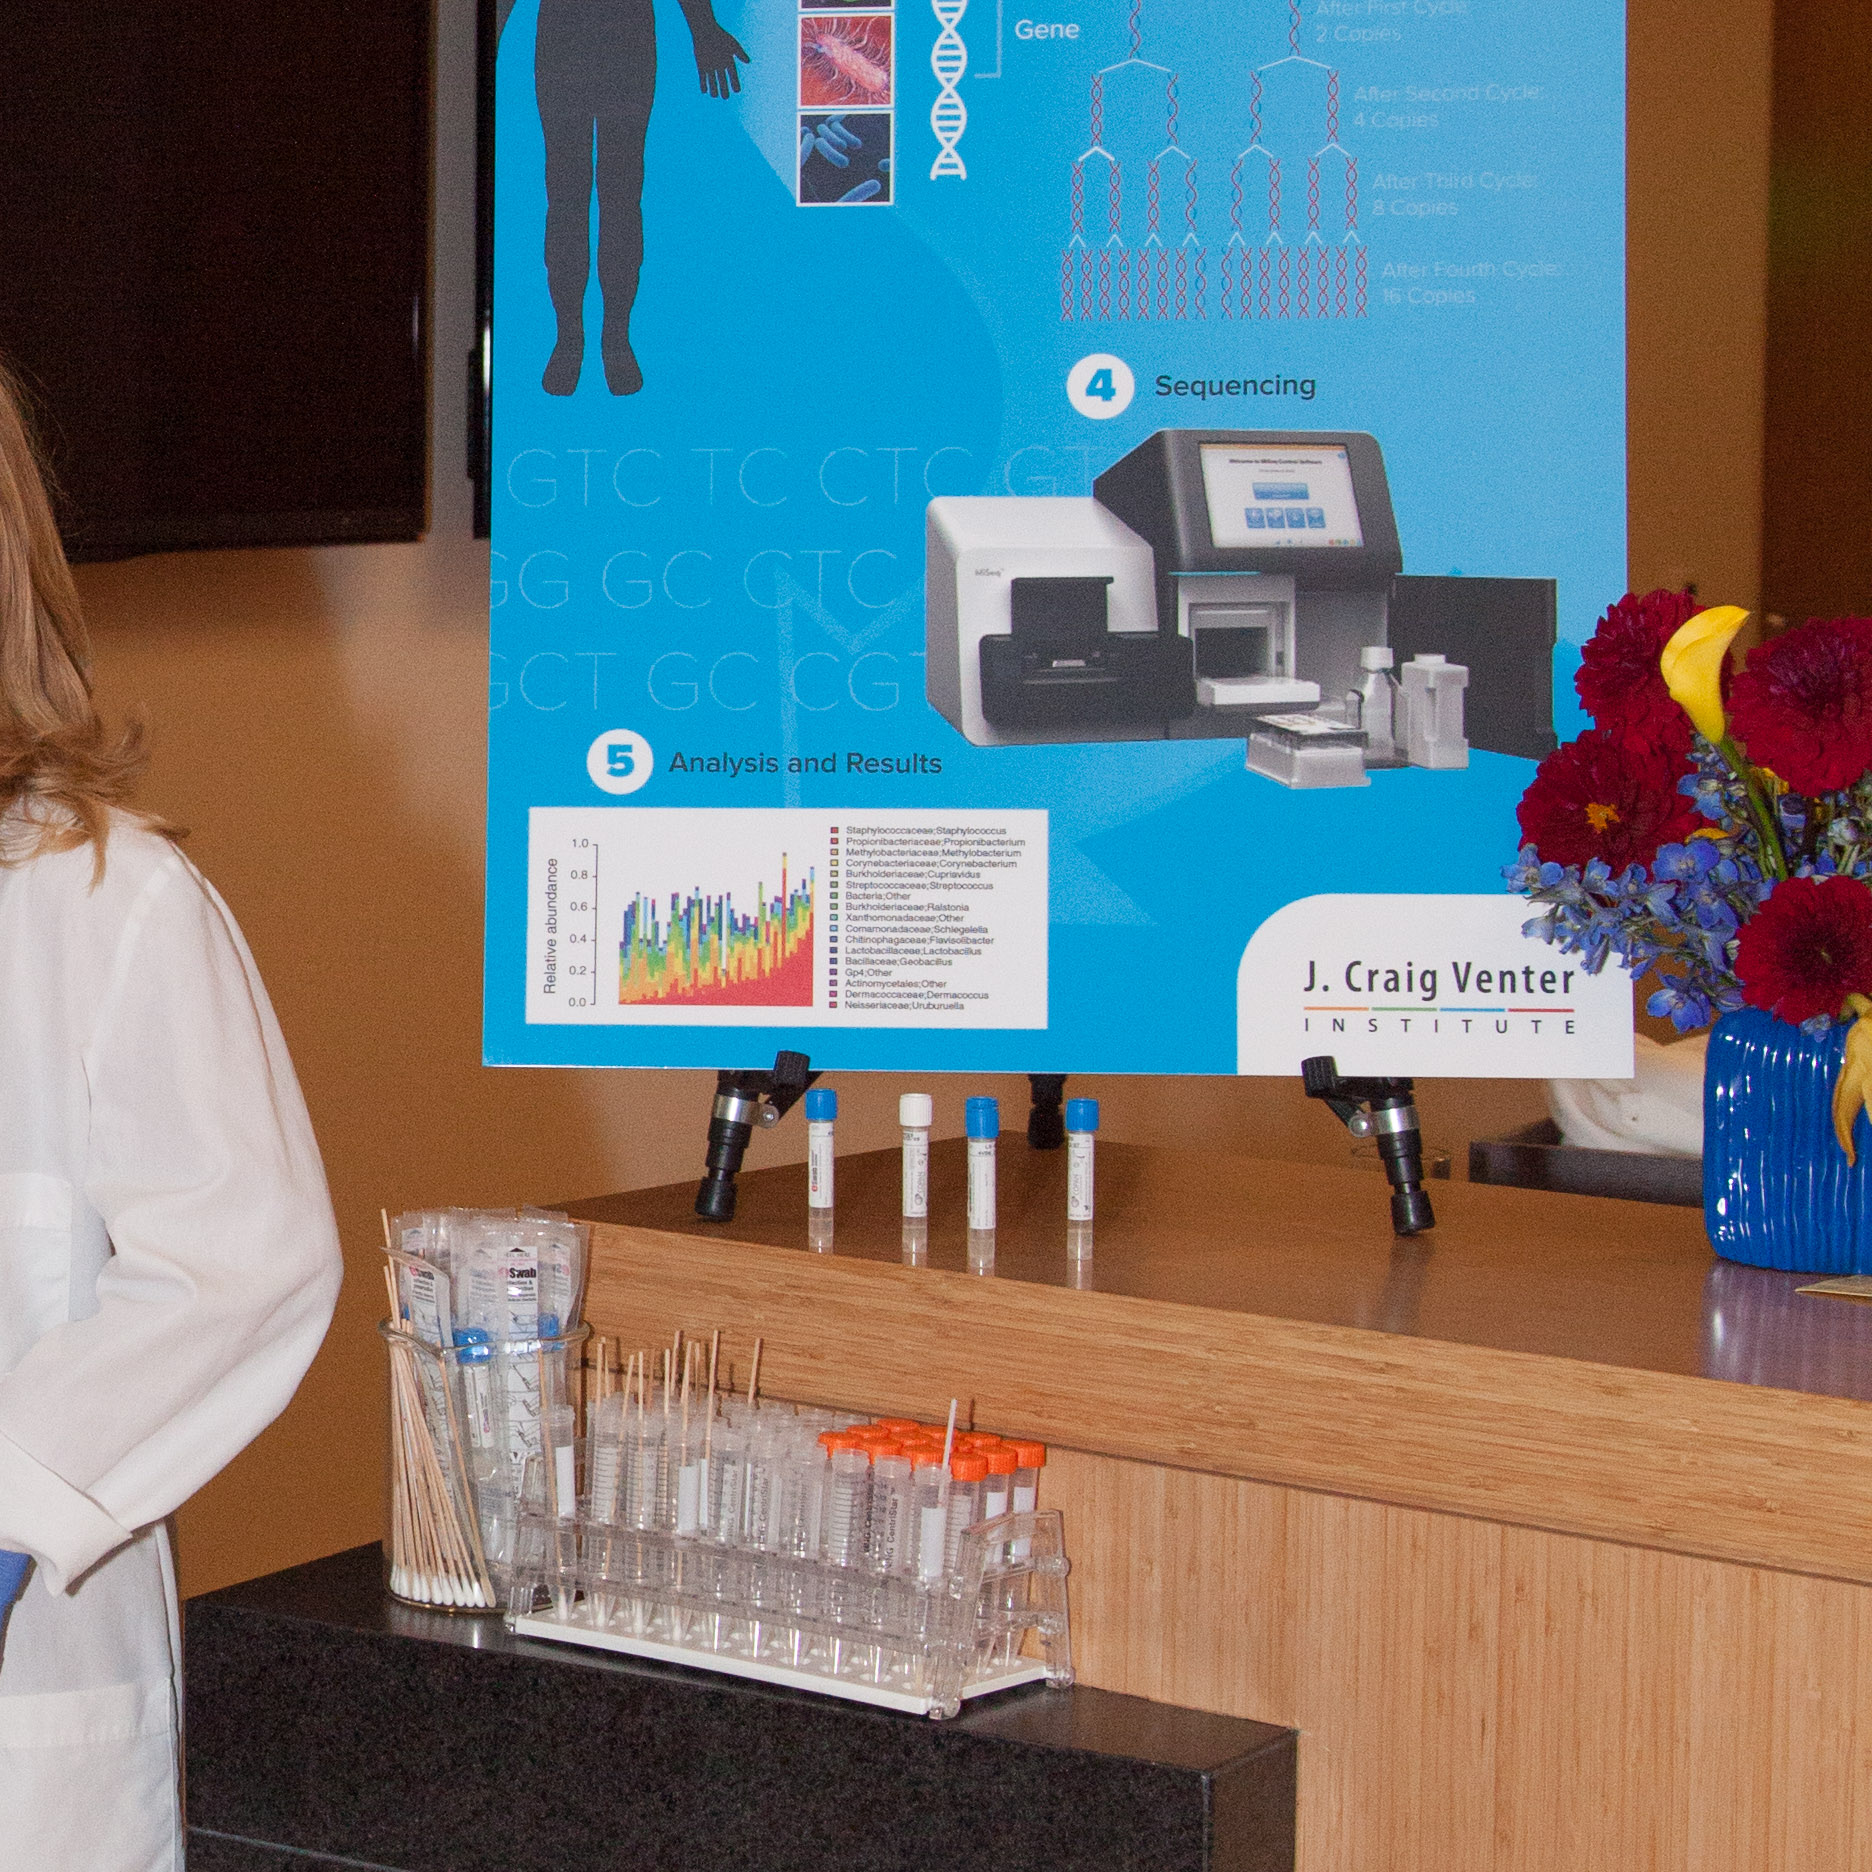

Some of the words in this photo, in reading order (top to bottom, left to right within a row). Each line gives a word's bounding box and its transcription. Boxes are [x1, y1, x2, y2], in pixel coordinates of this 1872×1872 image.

[1015, 19, 1080, 39] Gene
[1086, 369, 1116, 401] 4
[1156, 375, 1315, 401] Sequencing
[507, 448, 660, 507] GTC
[791, 651, 900, 712] CG
[608, 745, 634, 776] 5
[669, 752, 778, 778] Analysis
[788, 753, 836, 773] and
[847, 752, 942, 773] Results
[573, 838, 589, 848] 1.0
[571, 870, 588, 879] 0.8
[545, 857, 558, 936] abundance
[570, 902, 587, 911] 0.6
[846, 891, 911, 901] Bacteria;Other
[570, 934, 586, 943] 0.4
[543, 939, 557, 995] Relative
[569, 966, 586, 975] 0.2
[1304, 961, 1329, 992] J.
[1345, 961, 1436, 1001] Craig
[1452, 962, 1574, 994] Venter
[568, 997, 586, 1007] 0.0
[1305, 1018, 1574, 1034] INSTITUTE
[887, 1498, 899, 1543] CentriStar
